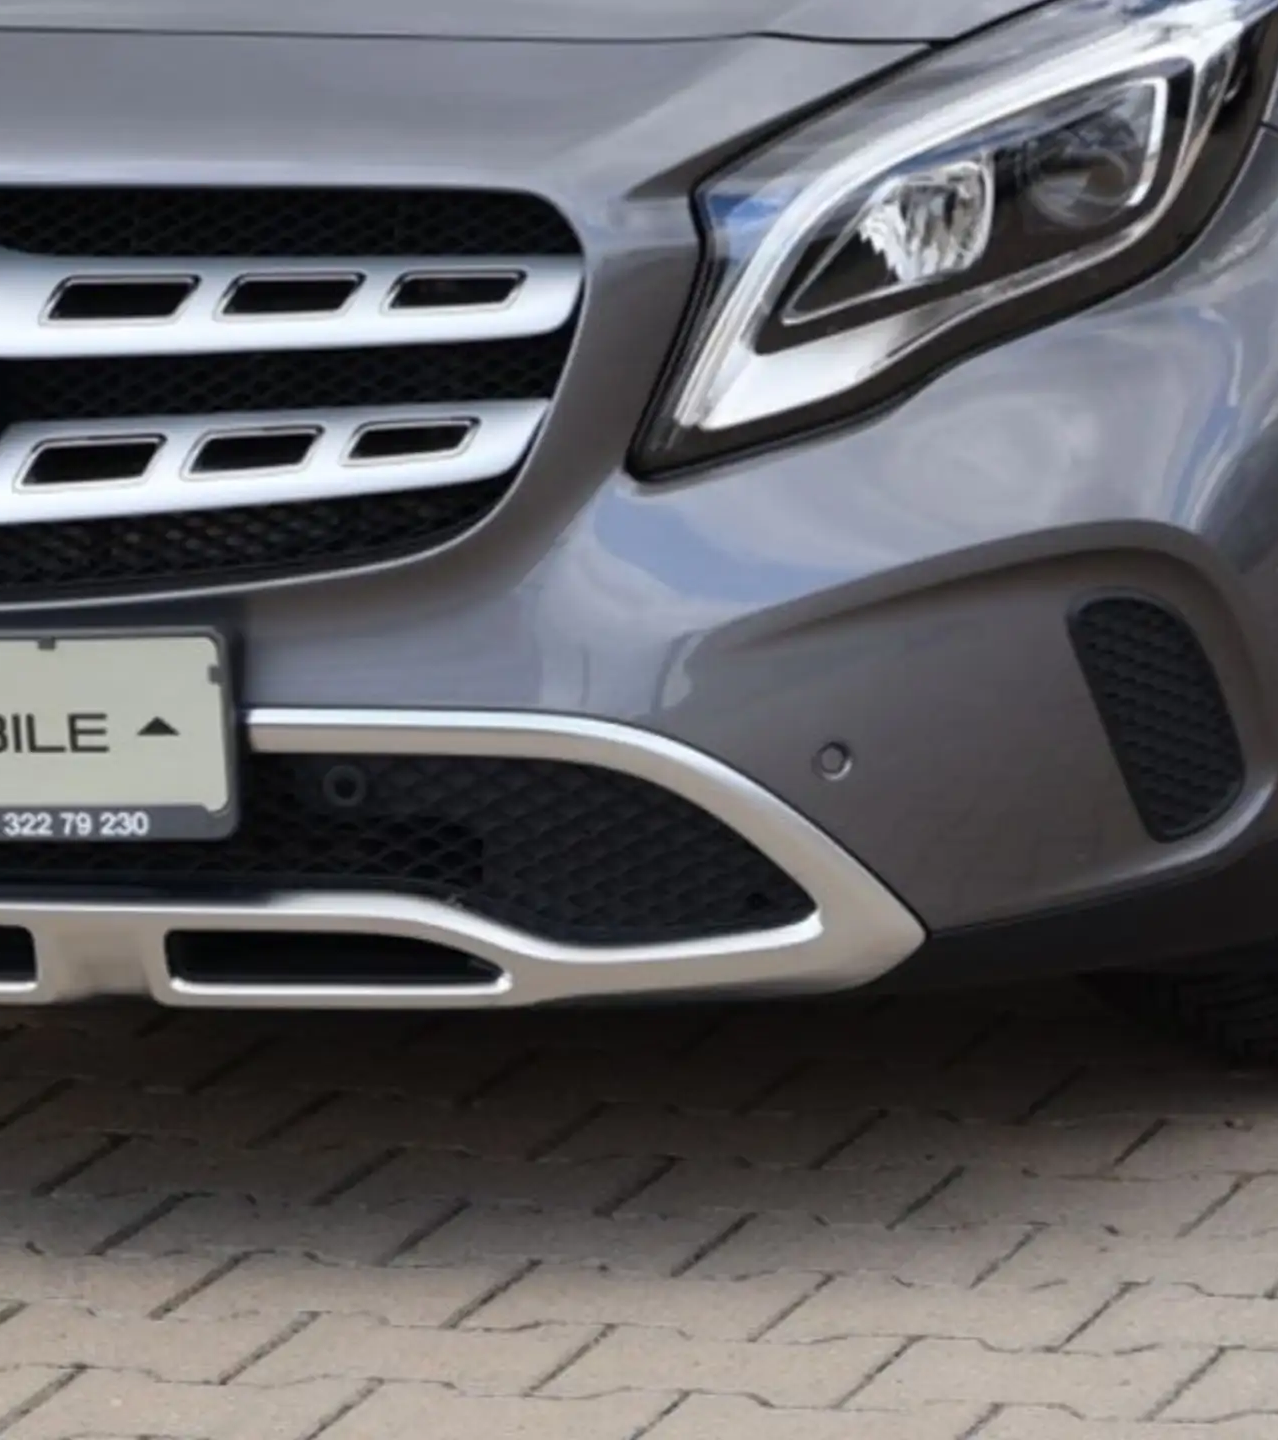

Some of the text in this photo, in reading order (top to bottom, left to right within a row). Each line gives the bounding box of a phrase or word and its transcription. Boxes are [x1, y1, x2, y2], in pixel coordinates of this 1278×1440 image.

[4, 812, 54, 836] 322
[60, 812, 93, 836] 79
[100, 811, 150, 836] 230
